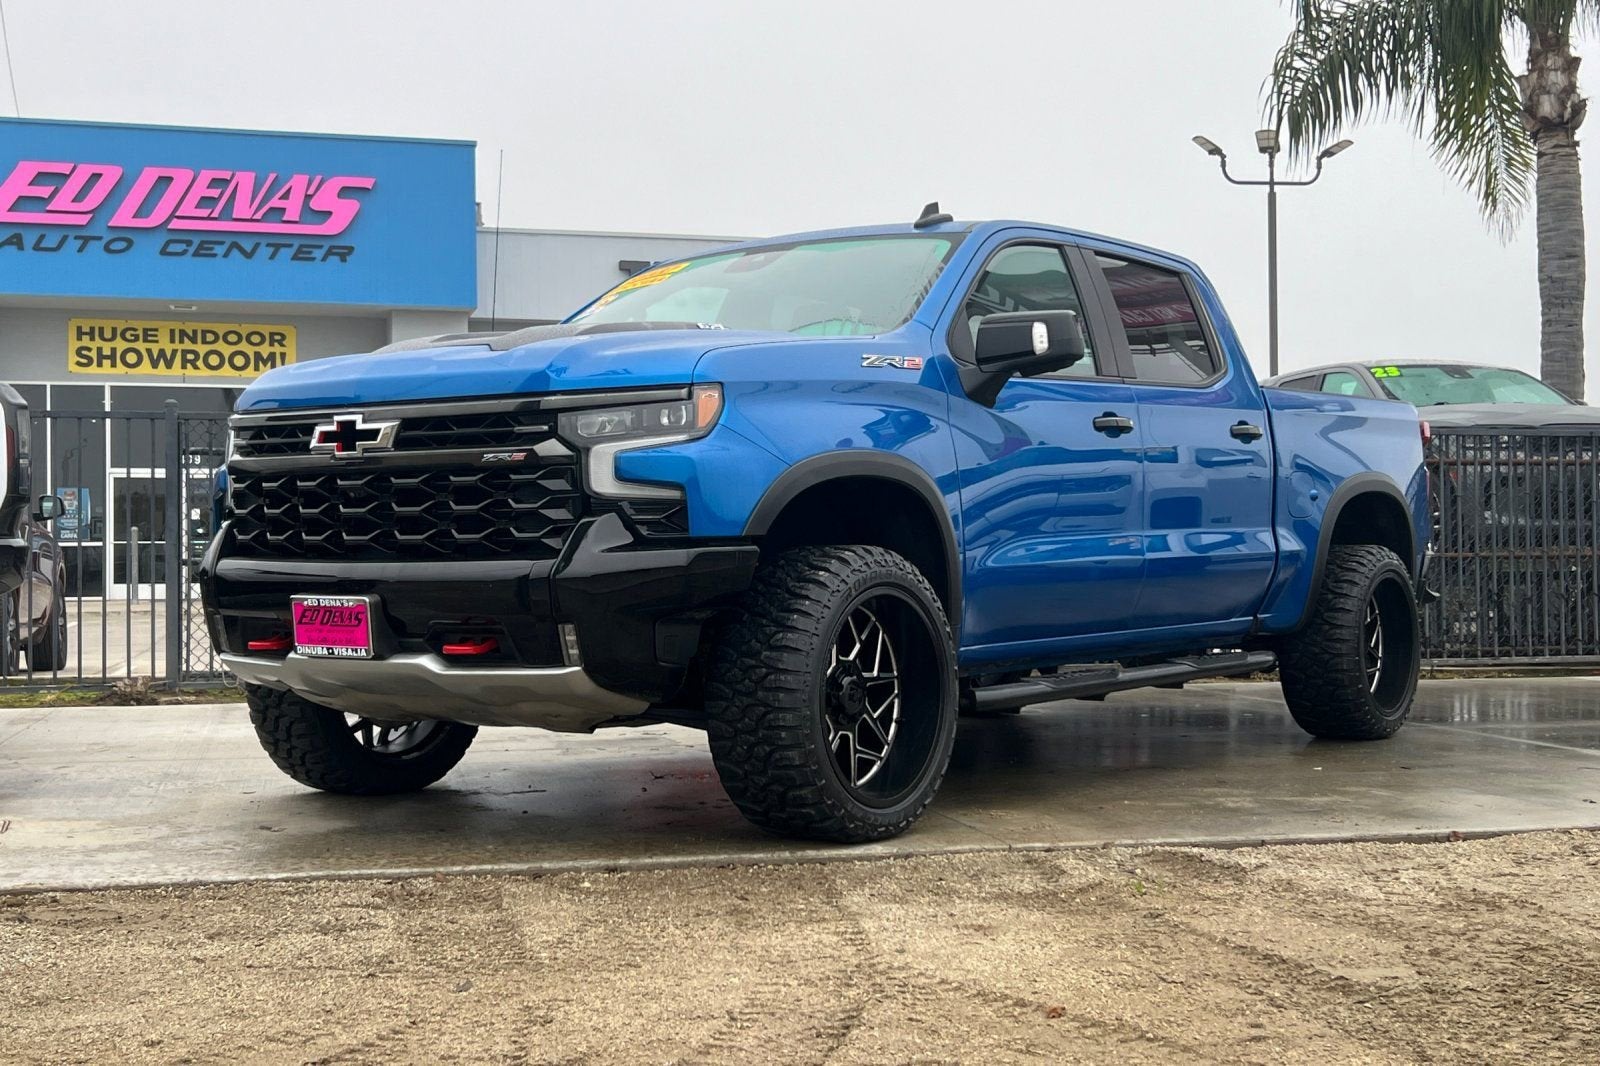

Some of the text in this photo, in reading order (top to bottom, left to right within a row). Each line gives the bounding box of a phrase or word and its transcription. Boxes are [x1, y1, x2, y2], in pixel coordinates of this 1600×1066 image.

[0, 160, 376, 236] ED DENA'S
[0, 232, 355, 263] AUTO CENTER
[75, 325, 288, 347] HUGE INDOOR
[74, 346, 287, 372] SHOWROOM!
[861, 354, 923, 370] ZR2
[1370, 366, 1401, 378] 23
[297, 608, 320, 625] ED
[297, 646, 367, 656] DINUBA VISALIA
